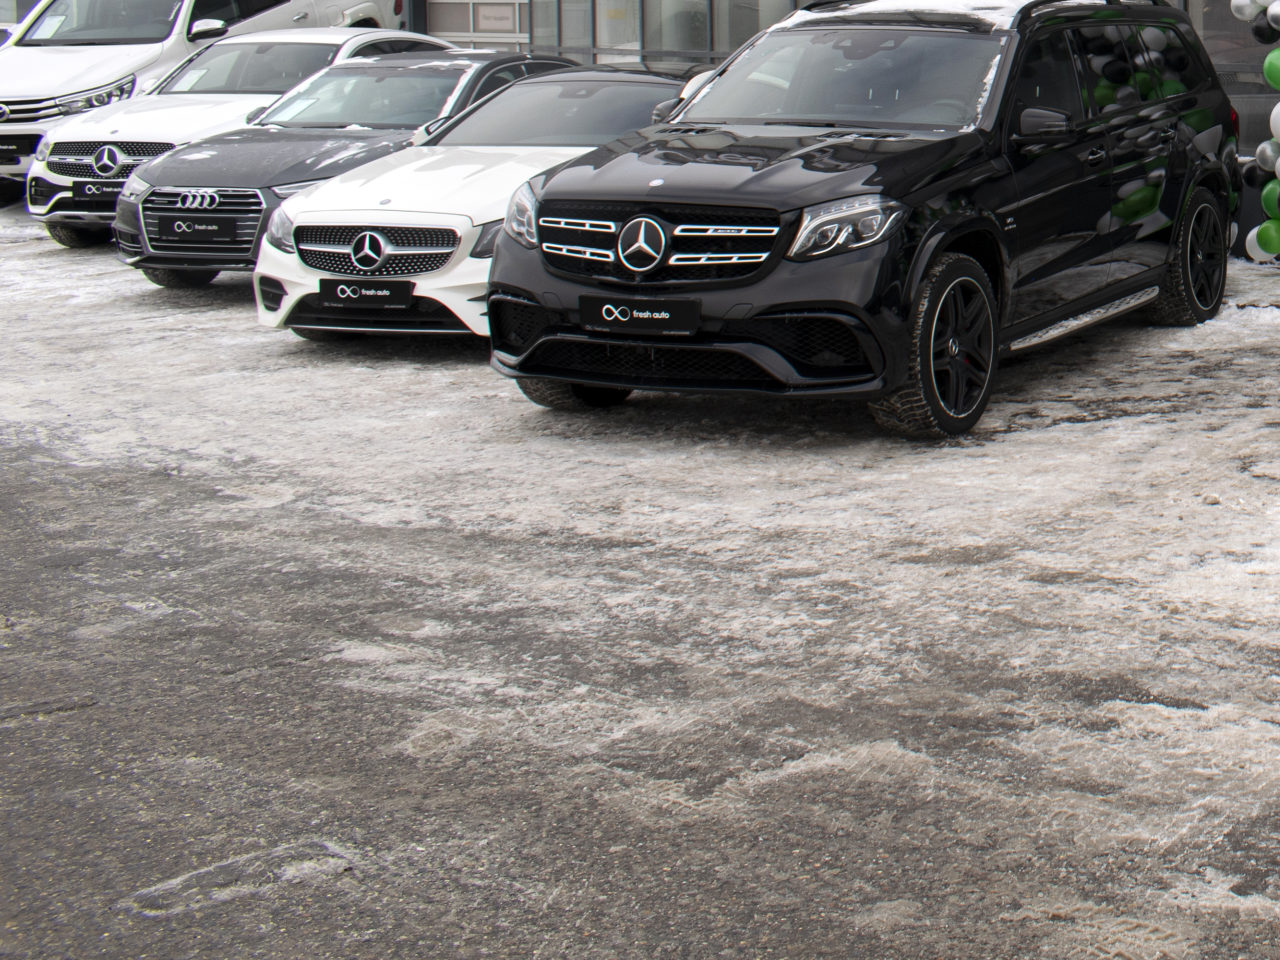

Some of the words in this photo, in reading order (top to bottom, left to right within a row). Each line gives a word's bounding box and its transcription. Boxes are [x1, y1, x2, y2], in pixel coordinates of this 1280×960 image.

[361, 288, 376, 296] fresh
[376, 289, 391, 297] auto
[632, 309, 652, 319] fresh
[652, 310, 670, 320] auto
